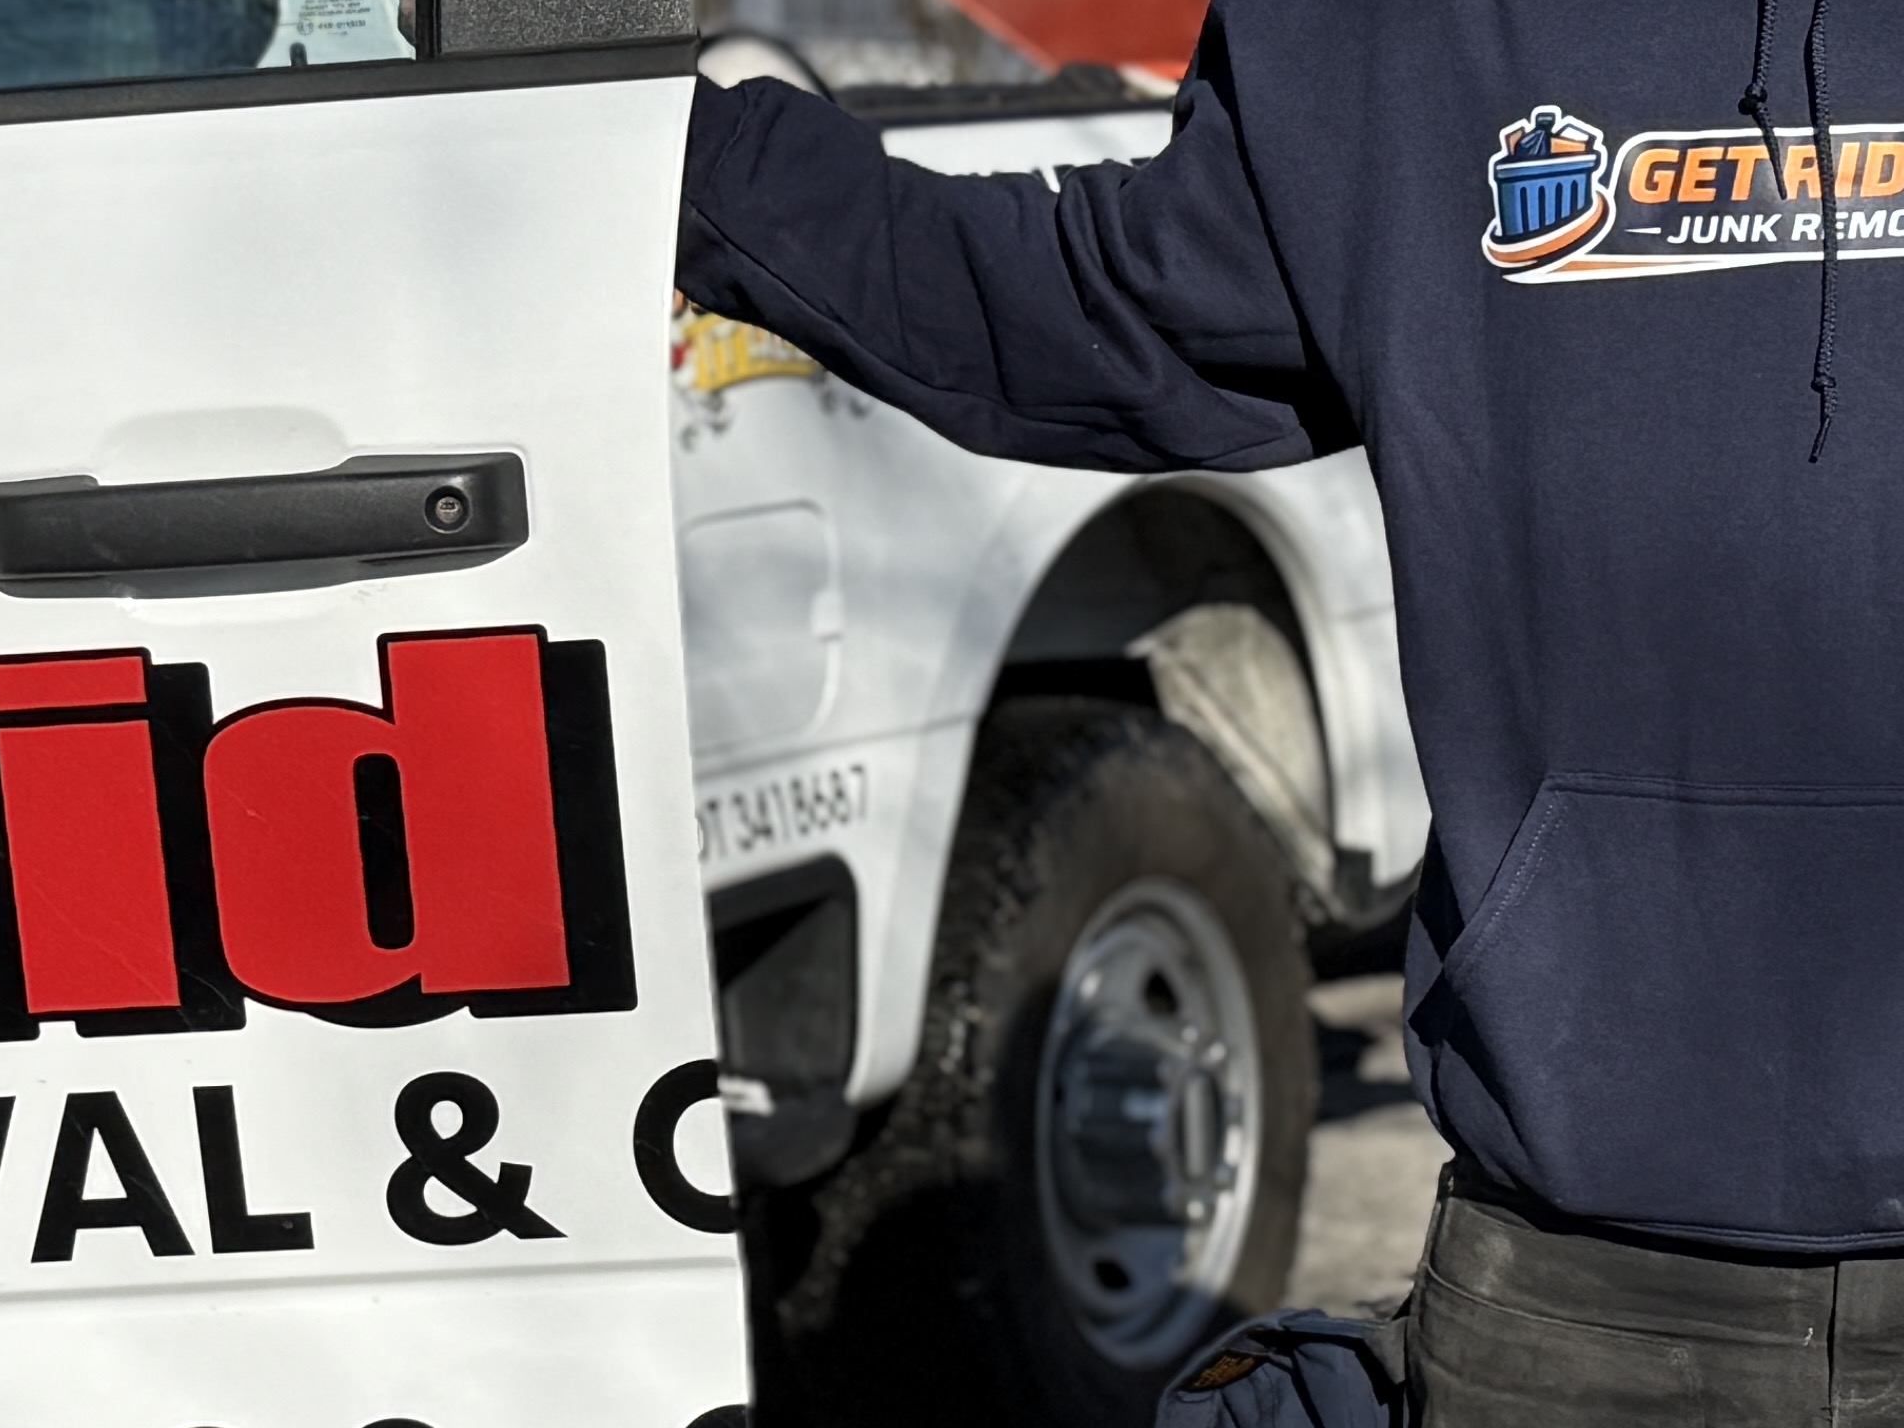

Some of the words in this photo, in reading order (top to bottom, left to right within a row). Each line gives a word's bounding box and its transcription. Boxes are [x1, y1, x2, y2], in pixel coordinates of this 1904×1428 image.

[1628, 145, 1772, 204] GET
[1667, 213, 1782, 245] JUNK
[386, 1071, 569, 1246] &
